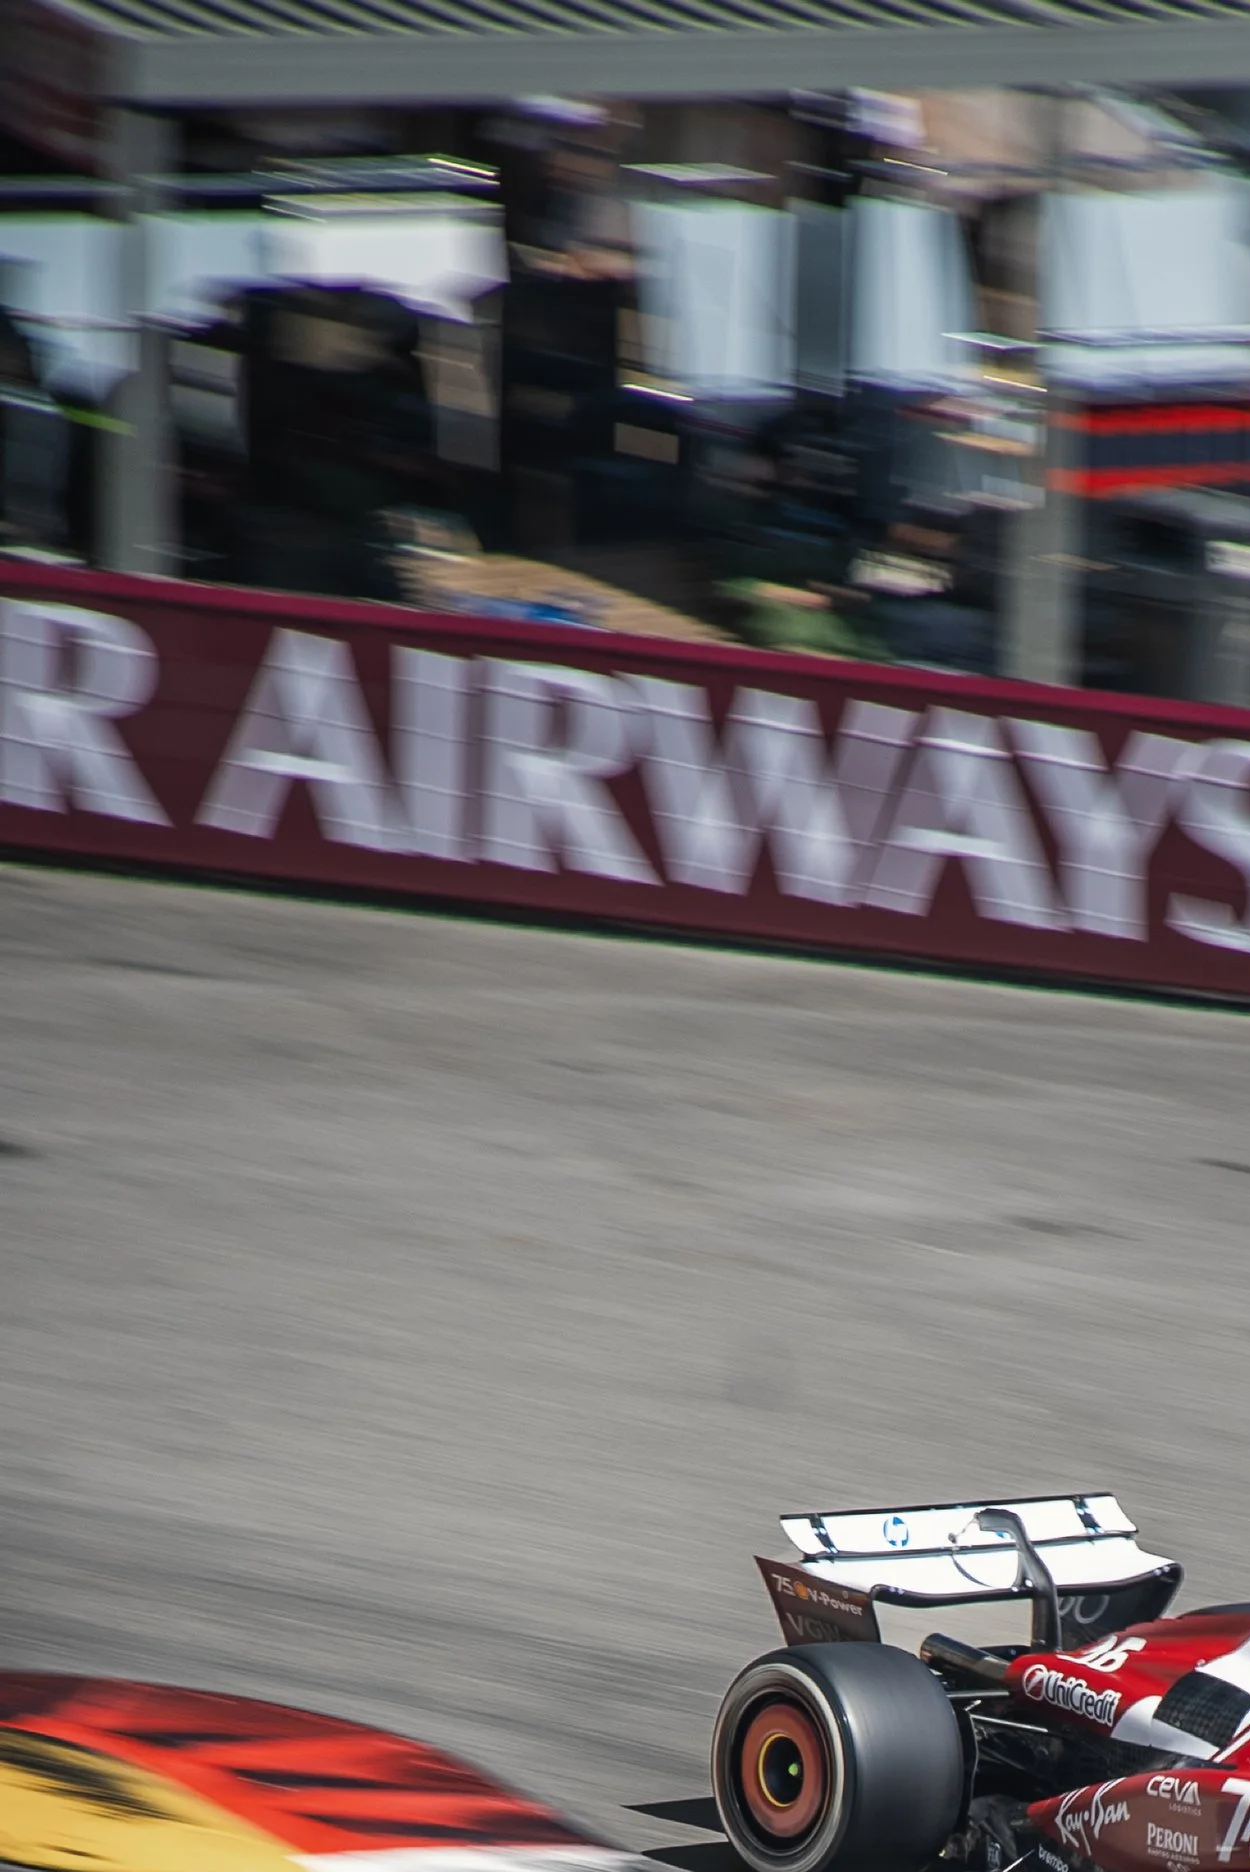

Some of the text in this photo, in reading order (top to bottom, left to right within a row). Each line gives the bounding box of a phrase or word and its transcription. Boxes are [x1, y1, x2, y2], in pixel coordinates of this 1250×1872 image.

[807, 1588, 863, 1616] V-Power
[1044, 1669, 1122, 1727] UniCredit
[1146, 1822, 1199, 1856] PERONI
